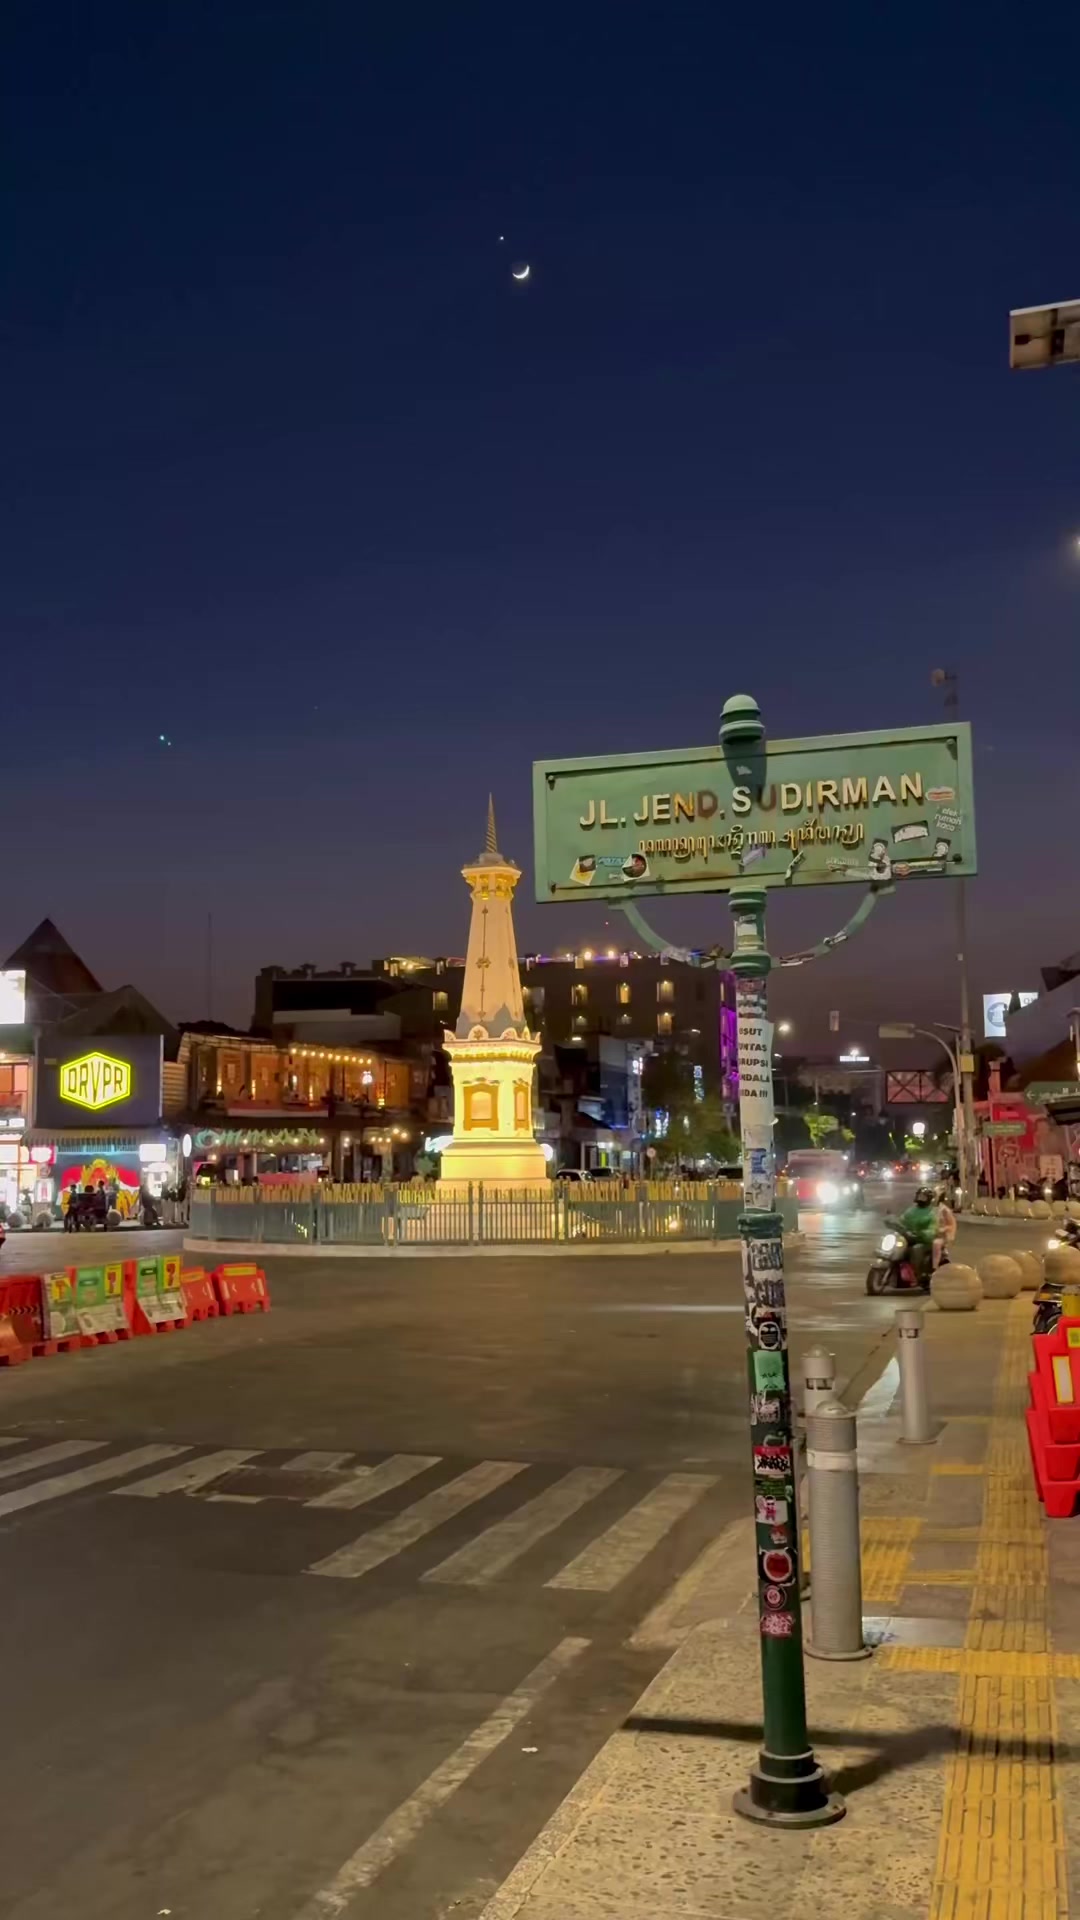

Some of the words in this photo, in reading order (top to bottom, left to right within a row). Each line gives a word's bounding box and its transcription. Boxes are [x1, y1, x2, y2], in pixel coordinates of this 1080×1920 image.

[579, 799, 627, 827] JL.
[633, 790, 726, 822] JEND.
[732, 771, 923, 813] SUDIRMAN
